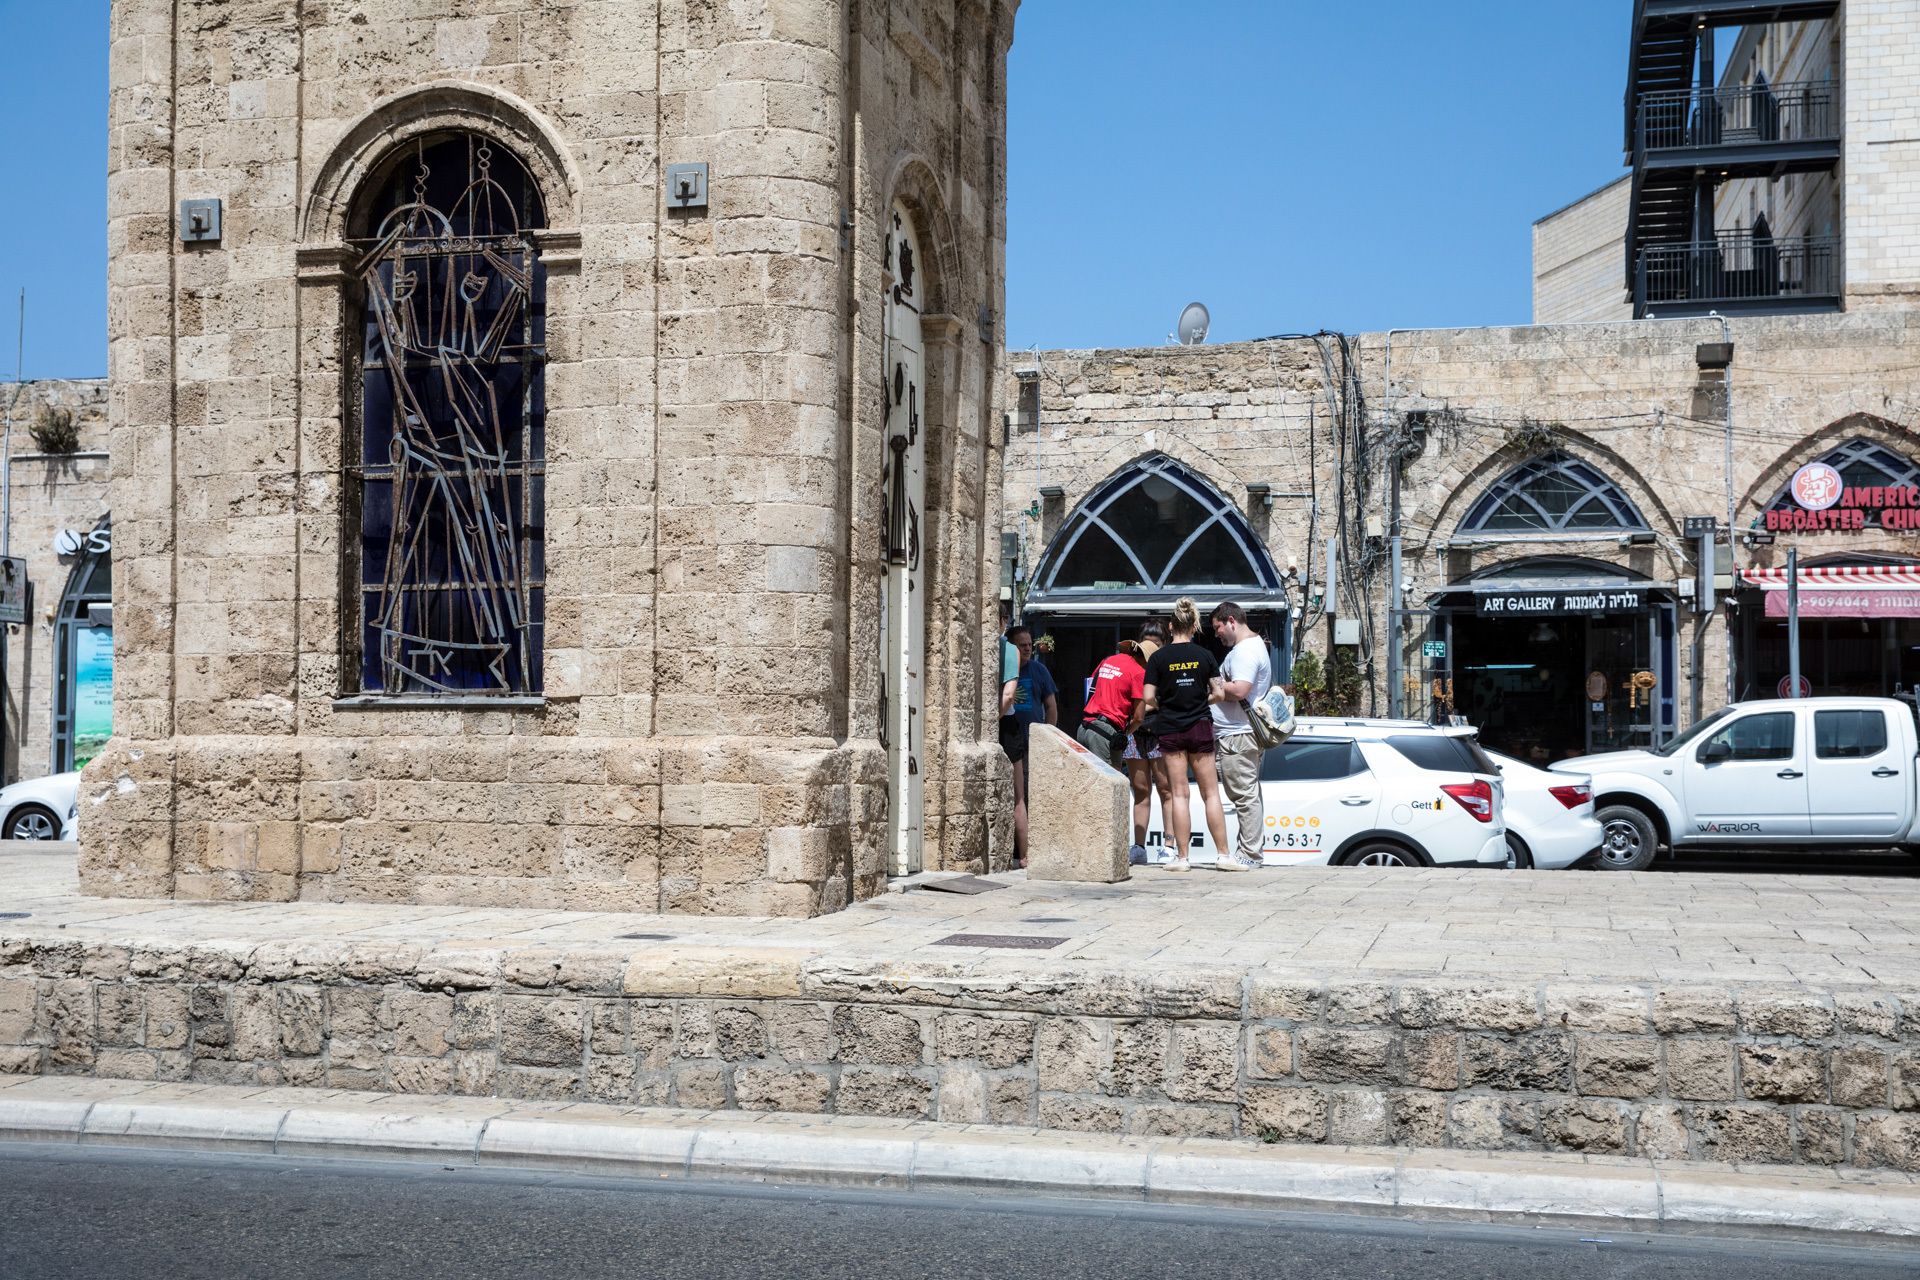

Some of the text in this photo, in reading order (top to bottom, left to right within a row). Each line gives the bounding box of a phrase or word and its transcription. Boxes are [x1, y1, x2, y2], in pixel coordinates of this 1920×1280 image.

[1766, 509, 1865, 530] BROASTER
[1484, 597, 1556, 611] ART GALLERY
[1564, 591, 1638, 610] גלריה לאומנות
[1169, 661, 1199, 671] STAFF
[1411, 800, 1432, 810] Gett
[1697, 821, 1762, 833] WARRIOR
